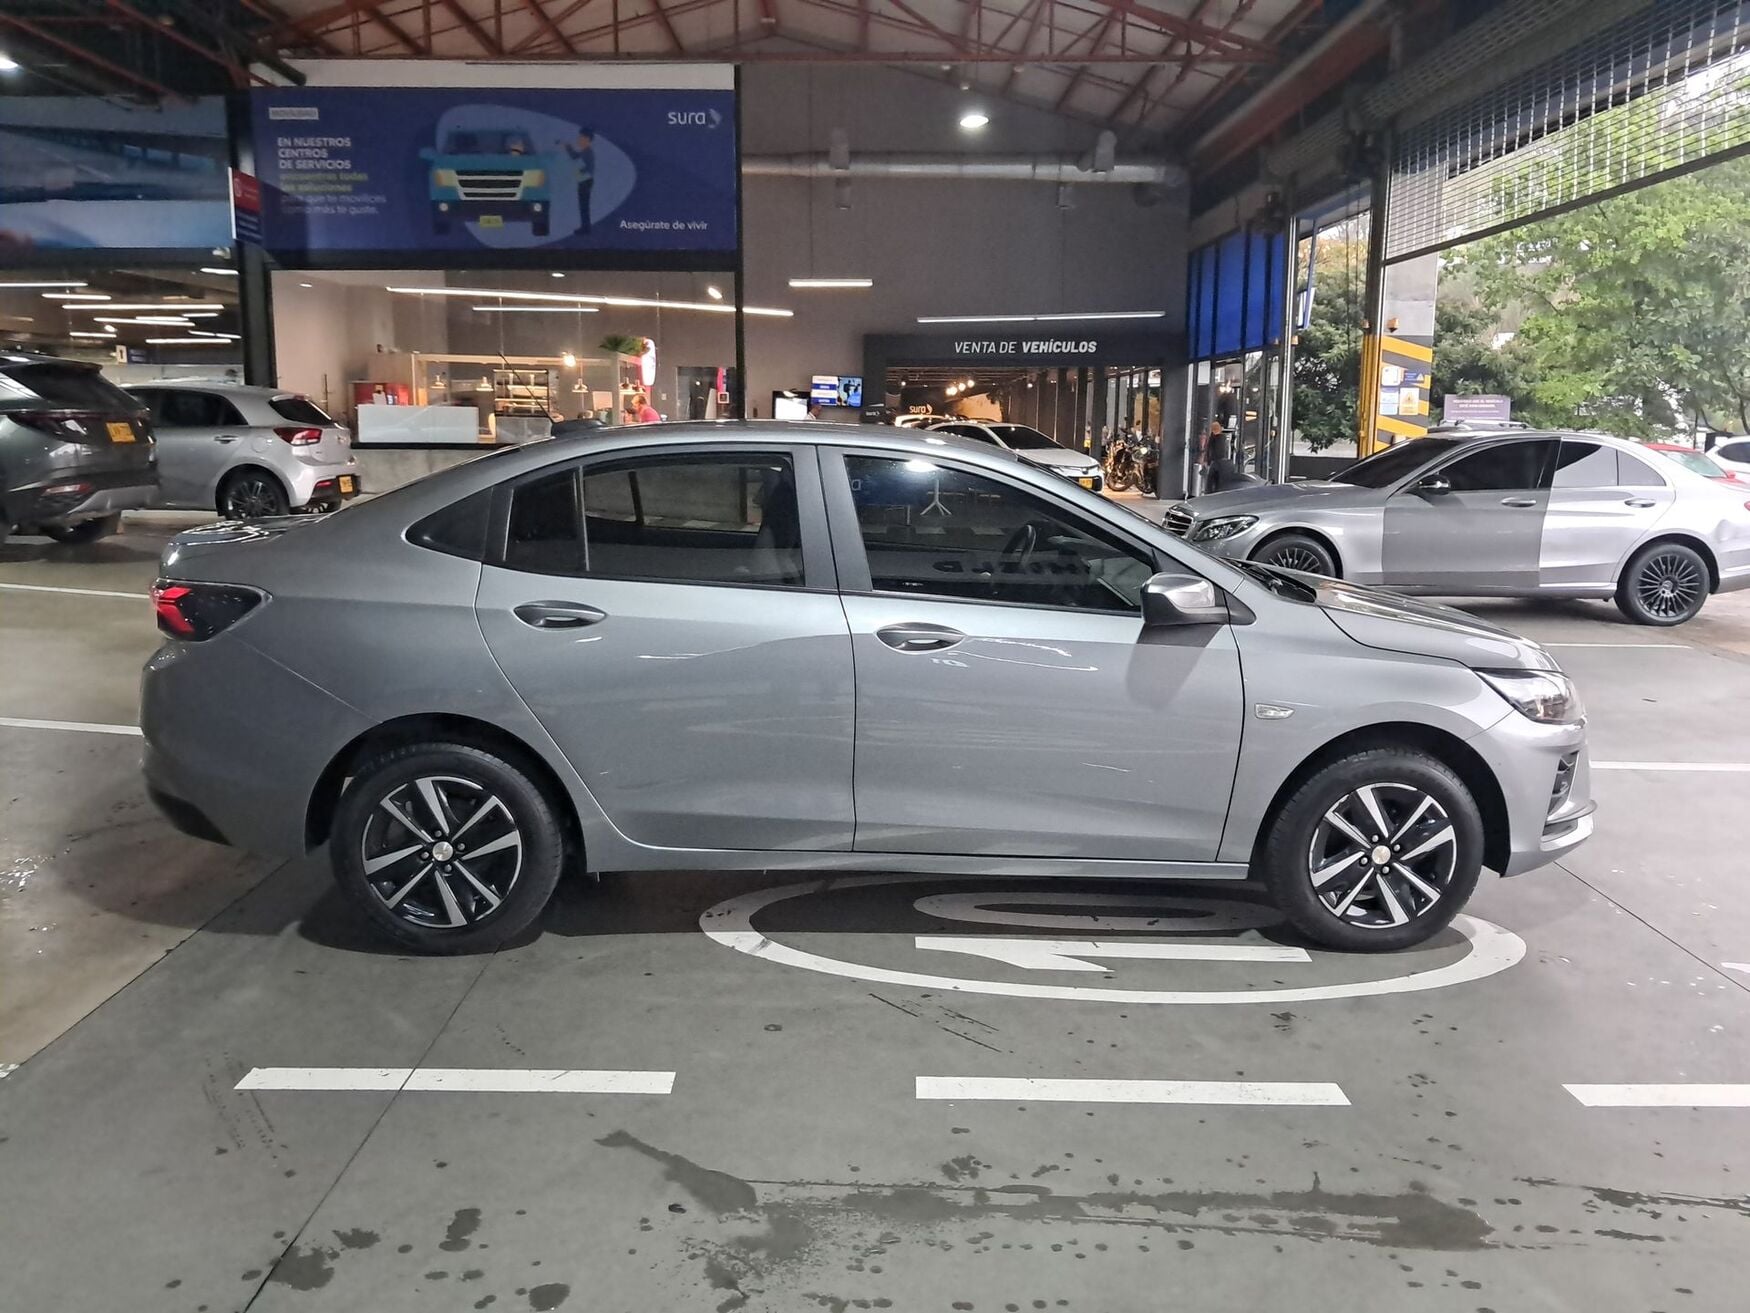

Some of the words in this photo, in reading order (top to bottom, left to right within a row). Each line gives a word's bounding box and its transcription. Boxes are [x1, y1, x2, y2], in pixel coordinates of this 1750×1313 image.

[667, 111, 706, 125] sura
[277, 137, 291, 147] EN
[293, 137, 352, 147] NUESTROS
[278, 148, 328, 158] CENTROS
[279, 159, 293, 169] DE
[295, 159, 352, 169] SERVICIOS
[305, 195, 326, 205] que
[326, 194, 337, 203] te
[619, 219, 670, 231] Asegúrate
[672, 220, 686, 230] de
[687, 220, 708, 230] vivir
[954, 341, 996, 354] VENTA
[999, 341, 1017, 354] DE
[1022, 338, 1098, 354] VEHÍCULOS
[909, 405, 927, 414] sura
